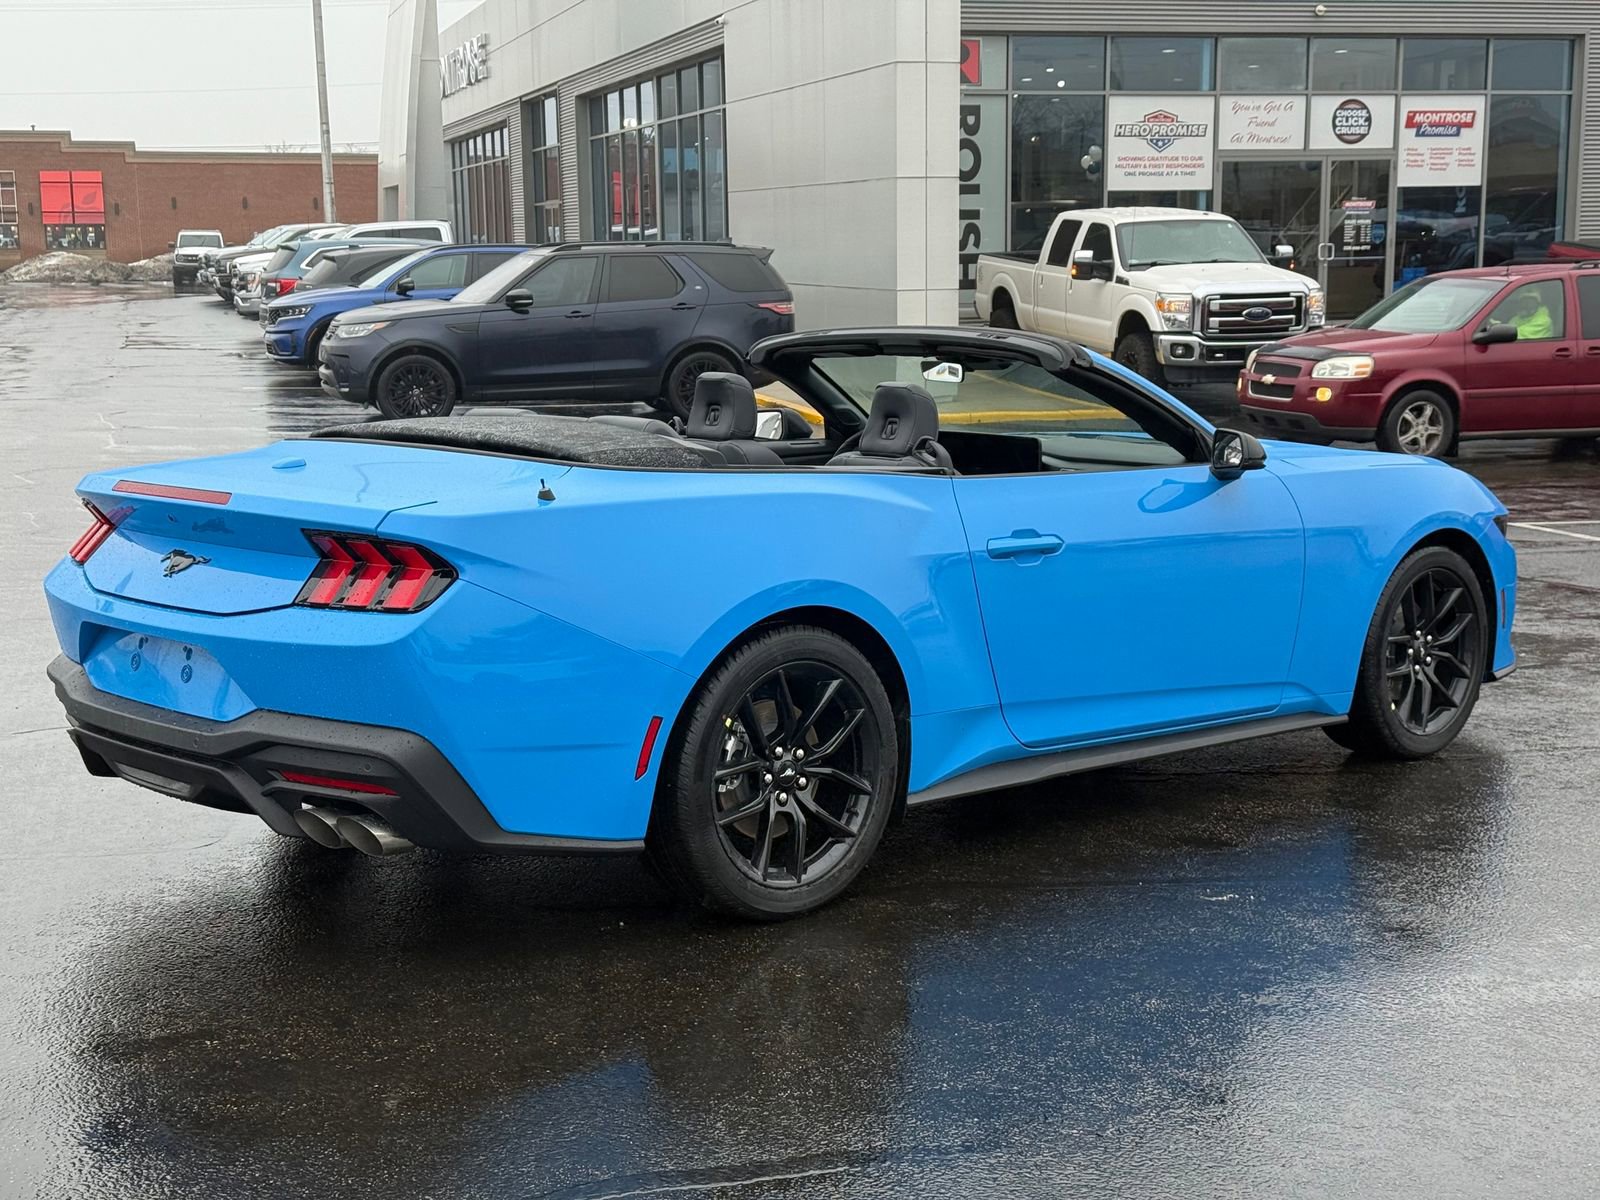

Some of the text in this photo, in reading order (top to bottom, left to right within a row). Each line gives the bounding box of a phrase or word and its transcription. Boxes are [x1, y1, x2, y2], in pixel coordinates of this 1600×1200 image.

[1336, 117, 1369, 126] CLICK.
[1413, 112, 1474, 123] MONTROSE
[1115, 124, 1208, 137] HERO PROMISE
[1419, 123, 1458, 135] Promise
